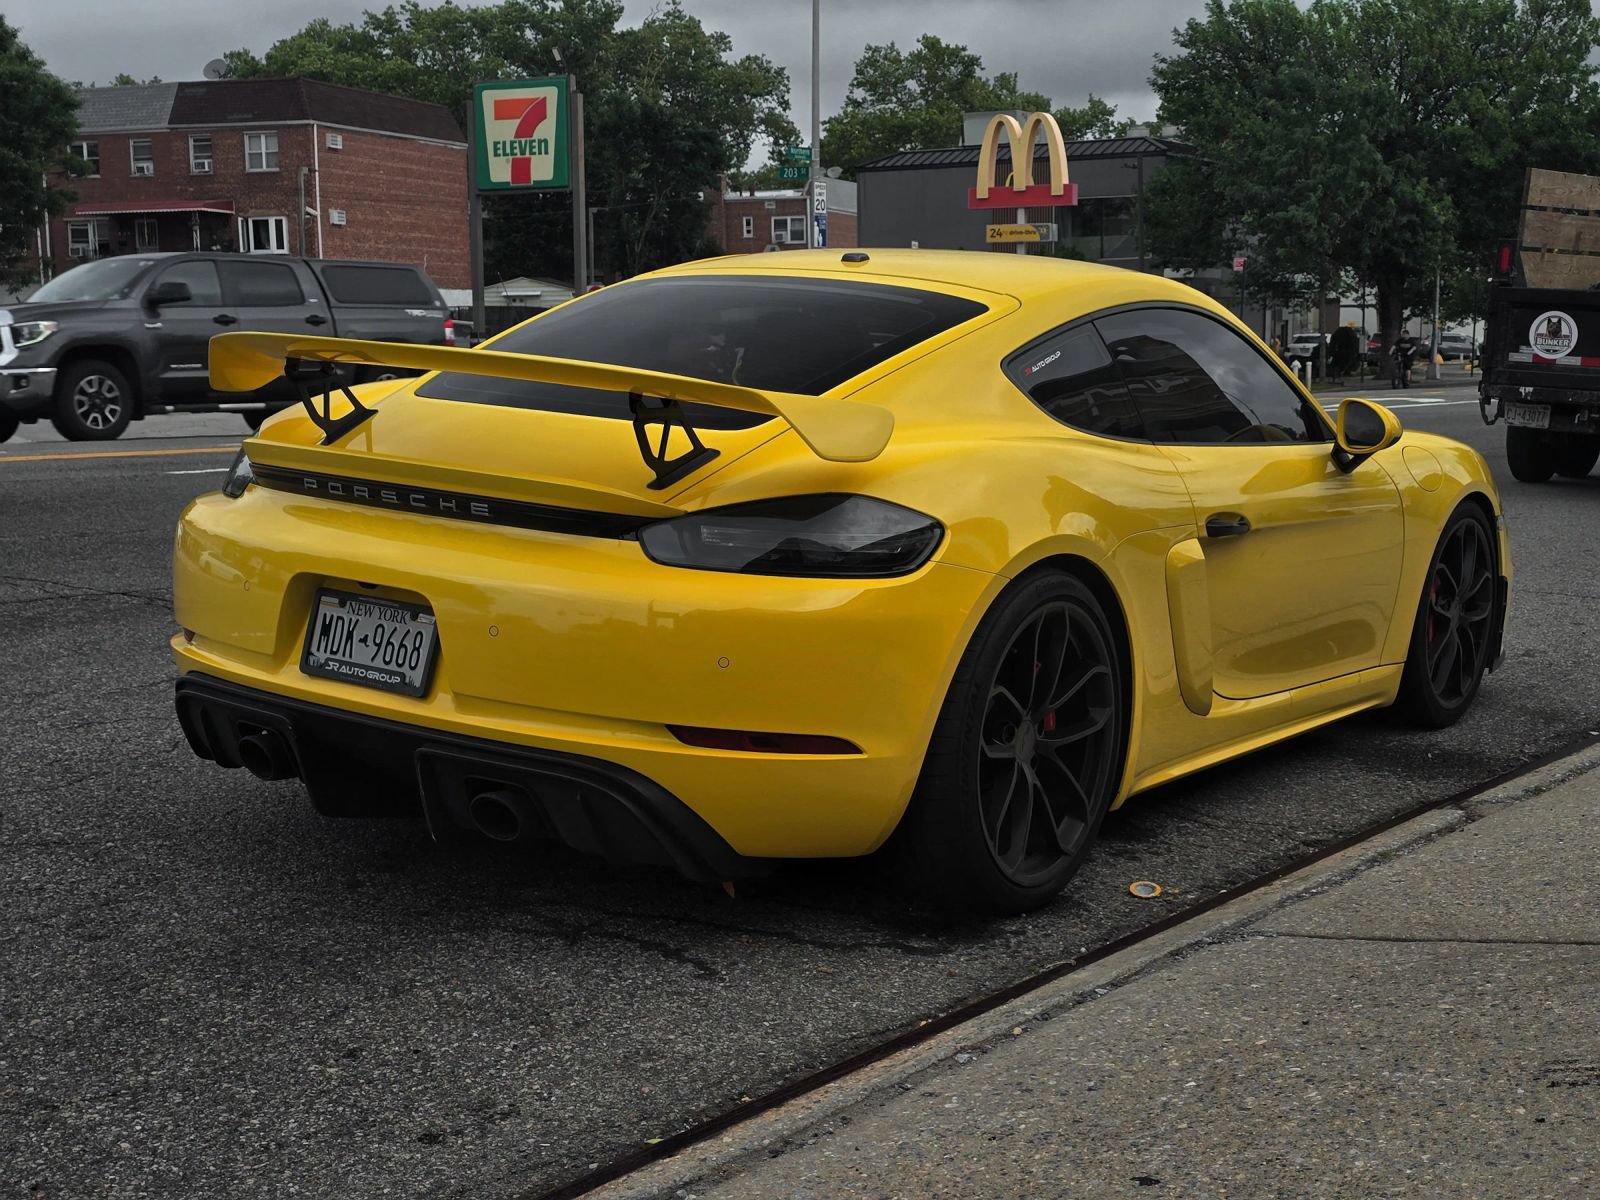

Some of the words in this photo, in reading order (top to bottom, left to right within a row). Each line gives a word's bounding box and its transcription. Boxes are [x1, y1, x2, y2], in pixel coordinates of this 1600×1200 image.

[494, 96, 547, 185] 7
[783, 168, 798, 178] 203
[816, 199, 825, 211] 20
[990, 228, 1003, 239] 24
[1537, 338, 1569, 346] BUNKER
[304, 478, 489, 516] PORSCHE
[346, 602, 376, 618] NEW
[377, 606, 410, 625] YORK
[317, 613, 359, 659] MDK
[370, 623, 424, 671] 9668
[338, 665, 366, 678] AUTO
[366, 670, 401, 684] GROUP
